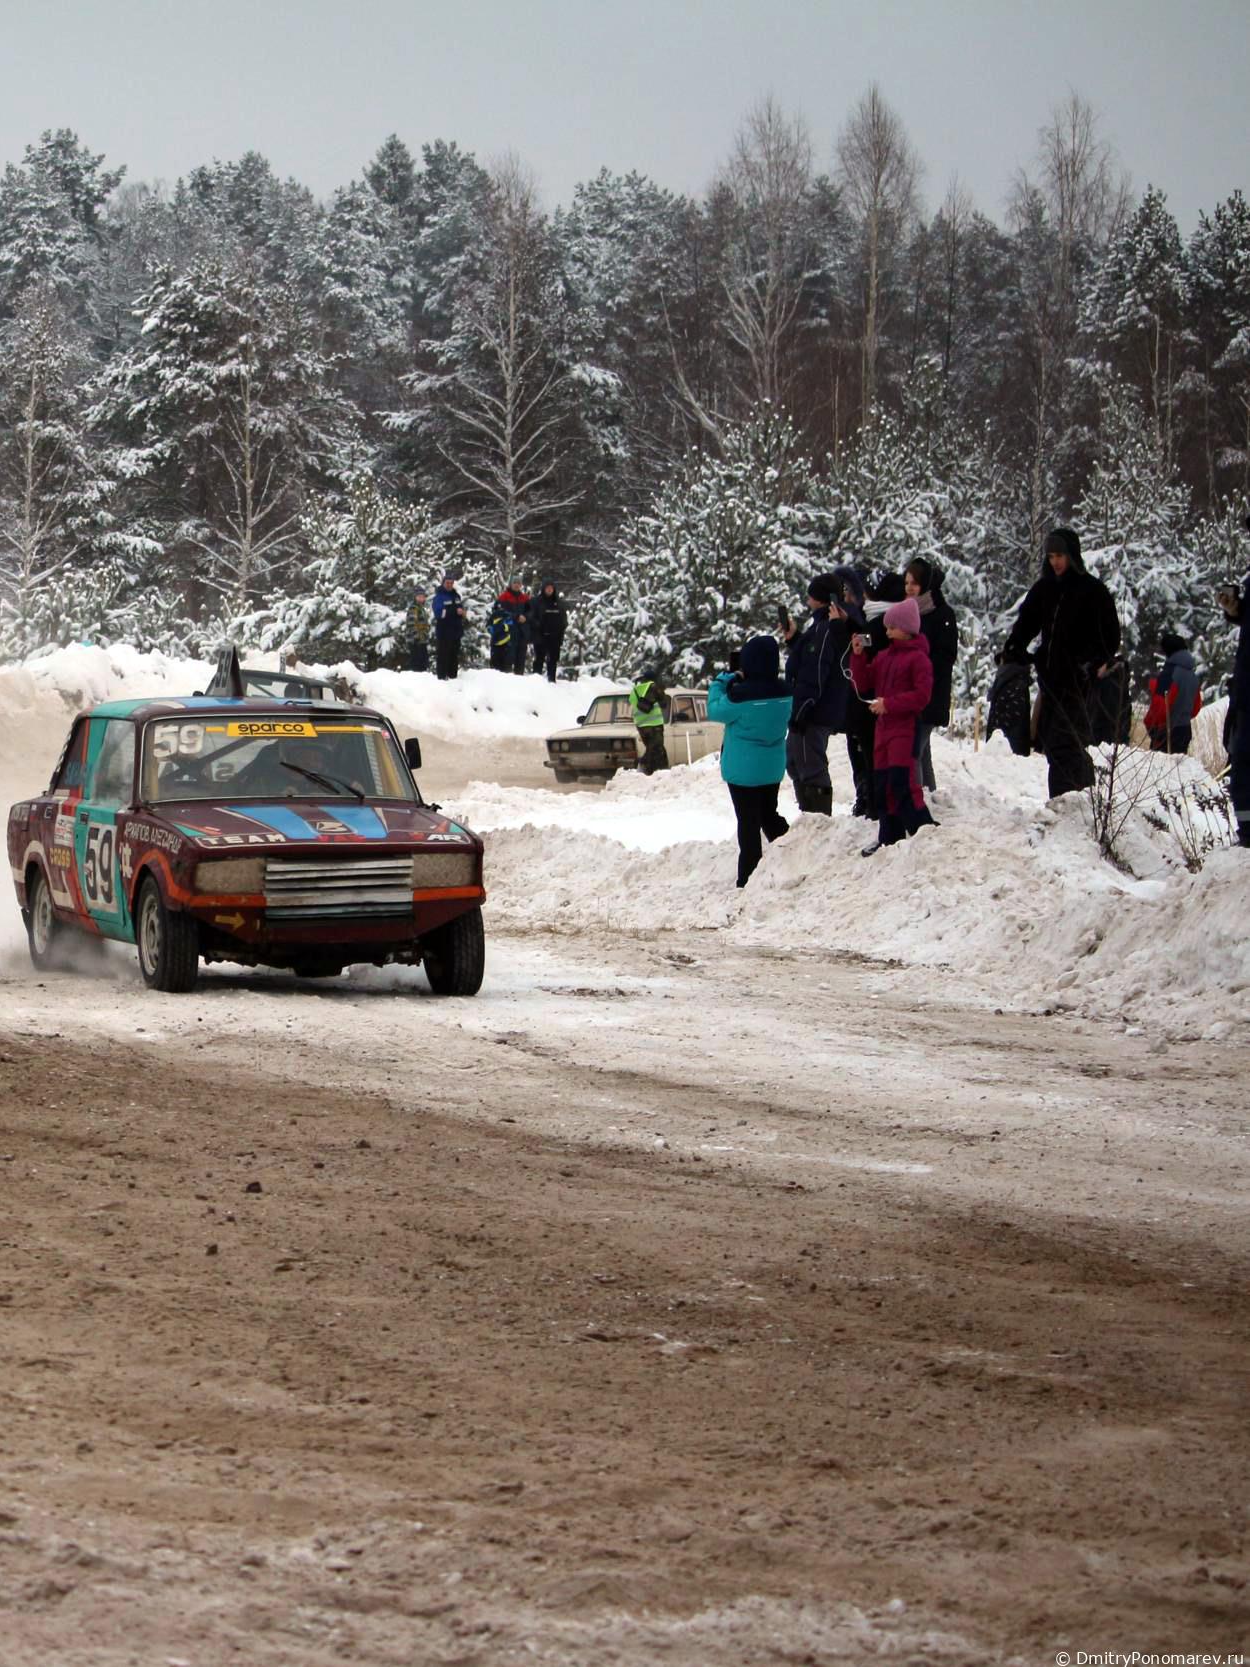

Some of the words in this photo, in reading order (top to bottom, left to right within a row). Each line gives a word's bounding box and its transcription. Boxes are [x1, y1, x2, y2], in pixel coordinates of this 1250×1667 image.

[153, 724, 205, 758] 59
[237, 722, 305, 736] sparco
[202, 833, 287, 845] TEAM
[85, 826, 113, 904] 59
